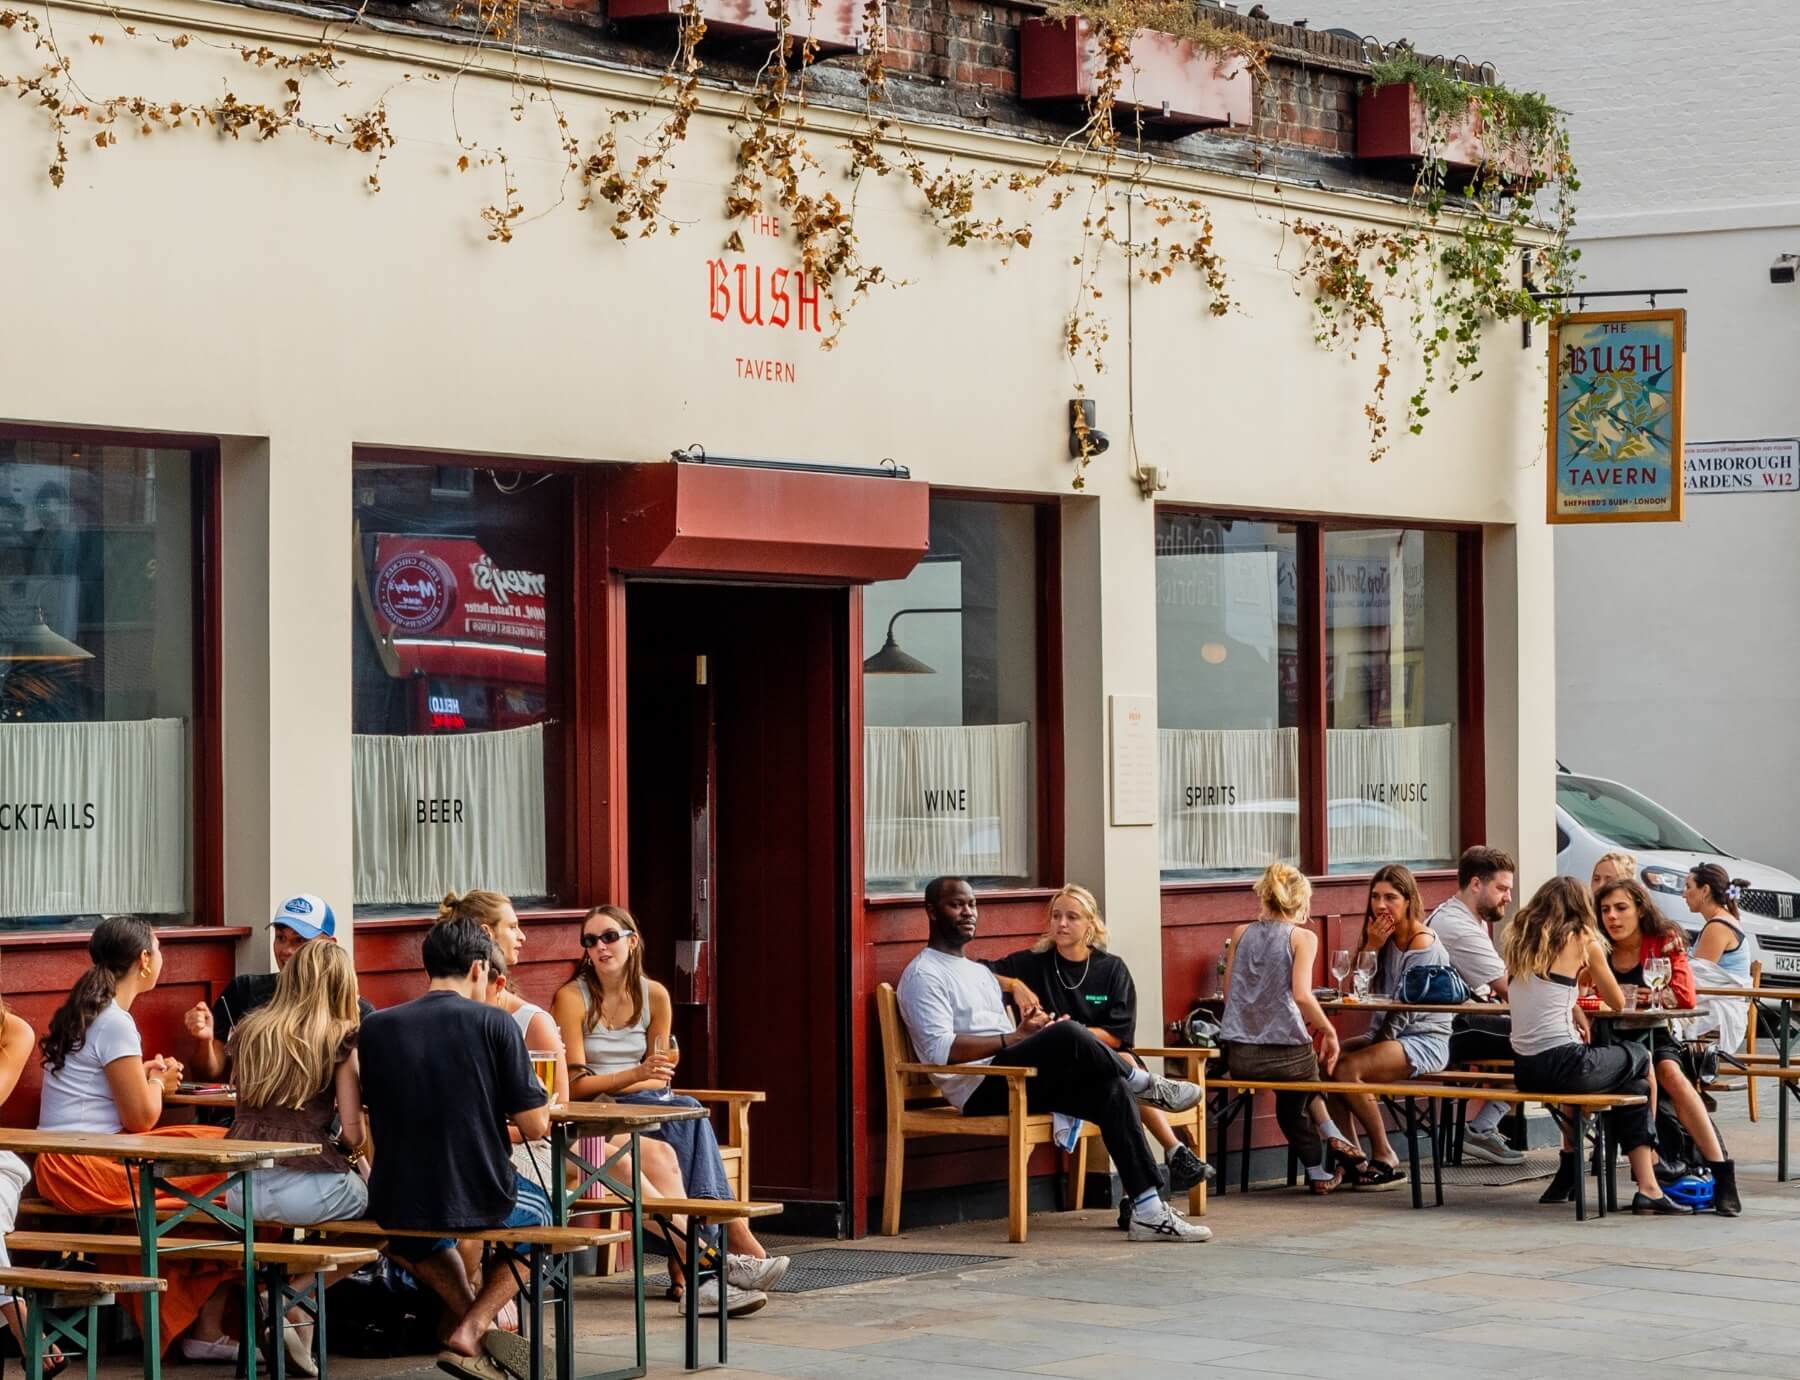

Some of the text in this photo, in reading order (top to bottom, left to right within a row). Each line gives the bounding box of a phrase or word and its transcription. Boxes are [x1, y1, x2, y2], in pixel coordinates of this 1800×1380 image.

[752, 214, 780, 238] THE
[706, 256, 822, 333] BUSH
[1602, 323, 1628, 335] THE
[1569, 343, 1663, 375] BUSH
[735, 357, 796, 384] TAVERN
[1684, 455, 1792, 472] AMBOROUGH
[1568, 466, 1658, 486] TAVERN
[1684, 472, 1793, 489] ARDENS W12
[1608, 497, 1629, 507] BUSH
[1634, 496, 1668, 506] LONDON
[924, 790, 966, 811] WINE
[1185, 786, 1236, 807] SPIRITS
[1360, 783, 1428, 802] LIVE MUSIC
[0, 802, 96, 831] CKTAILS
[416, 799, 464, 823] BEER
[1775, 955, 1795, 972] HX24
